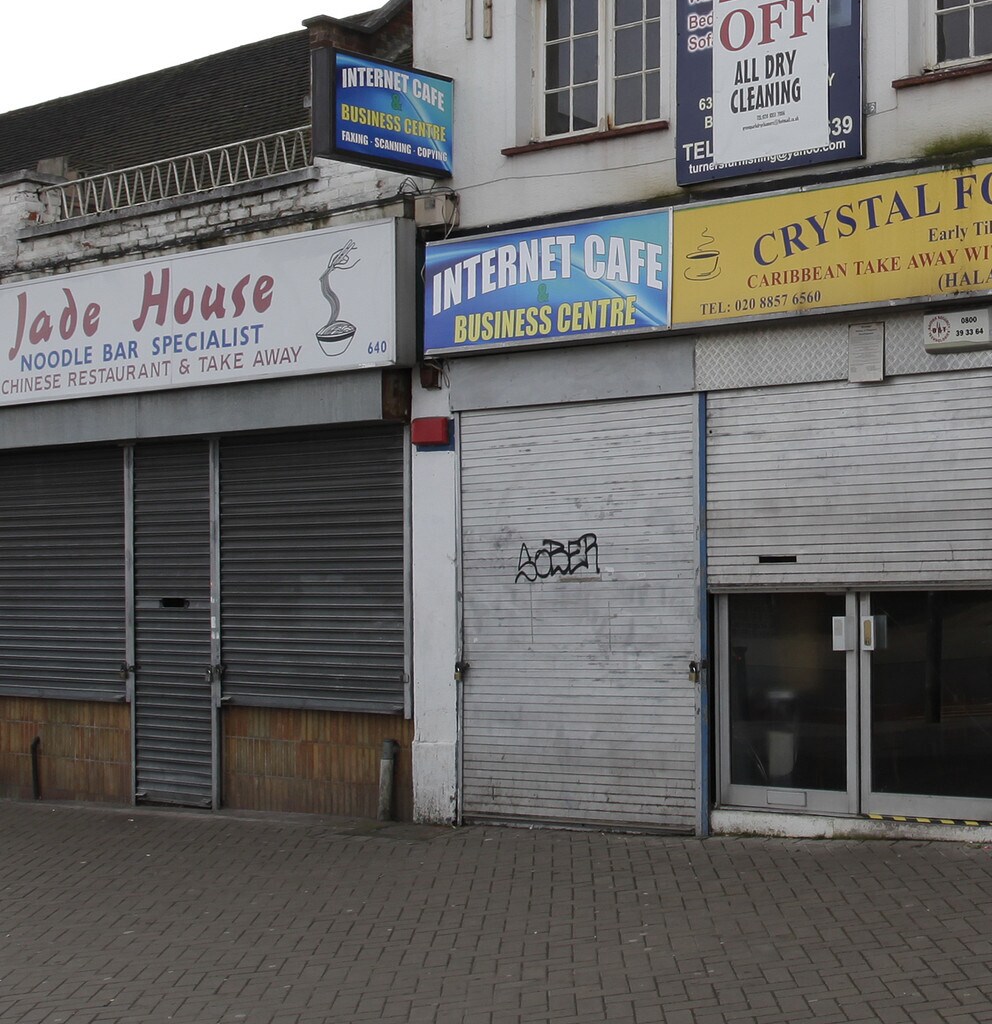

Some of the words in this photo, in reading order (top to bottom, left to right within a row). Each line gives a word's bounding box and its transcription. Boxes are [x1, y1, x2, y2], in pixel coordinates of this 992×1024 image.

[734, 57, 759, 86] ALL
[765, 49, 797, 78] DRY
[342, 67, 410, 93] INTERNET
[412, 78, 445, 112] CAFE
[730, 77, 801, 114] CLEANING
[341, 103, 401, 132] BUSINESS
[404, 118, 446, 142] CENTRE
[342, 130, 369, 146] FAXING
[374, 137, 411, 154] SCANNING
[417, 146, 447, 162] COPYING
[753, 183, 941, 266] CRYSTAL
[928, 225, 968, 242] Early
[432, 234, 576, 316] INTERNET
[584, 234, 663, 291] CAFE
[747, 263, 848, 289] CARIBBEAN
[853, 256, 901, 276] TAKE
[907, 249, 959, 269] AWAY
[537, 283, 549, 303] &
[700, 302, 731, 316] TEL:
[735, 298, 756, 312] 020
[759, 294, 788, 309] 8857
[792, 290, 822, 306] 6560
[8, 288, 101, 361] Jade
[132, 267, 274, 332] House
[454, 305, 552, 344] BUSINESS
[557, 295, 637, 333] CENTRE
[20, 346, 93, 372] NOODLE
[103, 340, 139, 362] BAR
[152, 324, 264, 356] SPECIALIST
[367, 340, 387, 355] 640
[1, 373, 61, 395] CHINESE
[68, 360, 171, 387] RESTAURANT
[179, 358, 190, 375] &
[199, 352, 244, 373] TAKE
[252, 345, 303, 367] AWAY
